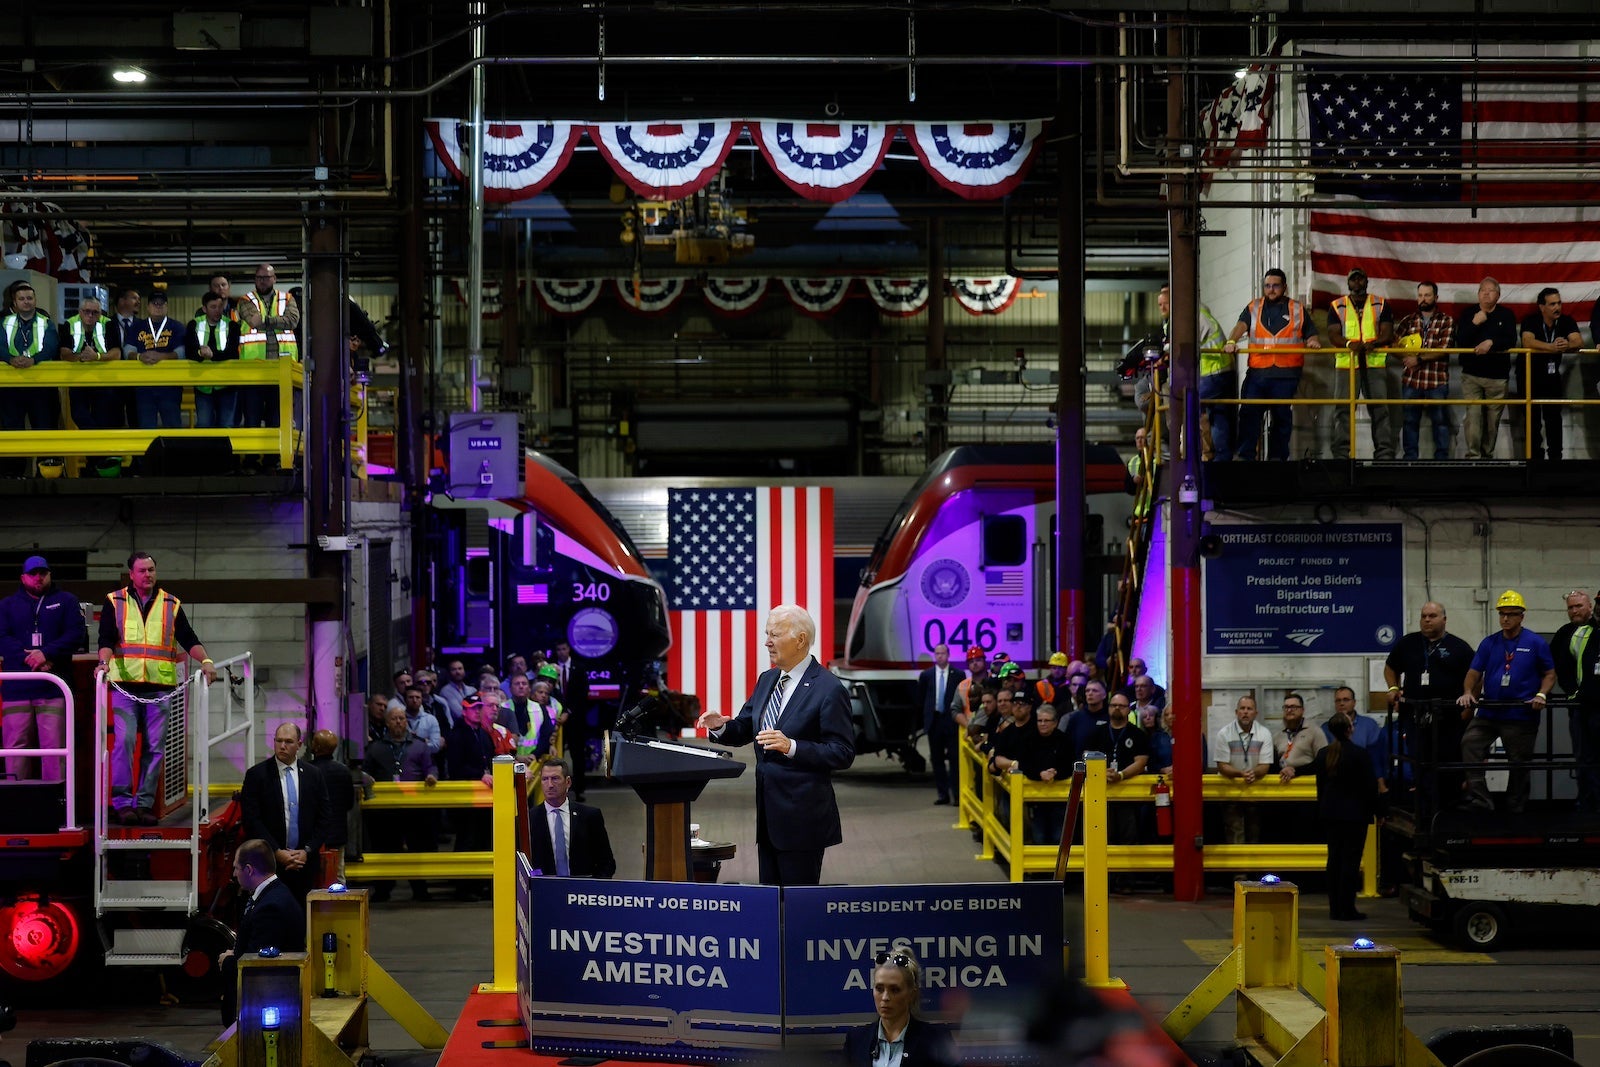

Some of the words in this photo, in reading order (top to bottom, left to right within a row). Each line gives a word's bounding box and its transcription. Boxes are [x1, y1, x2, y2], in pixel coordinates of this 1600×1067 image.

[1220, 533, 1272, 544] ORTHEAST
[1275, 533, 1323, 543] CORRIDOR
[1326, 532, 1392, 543] INVESTMENTS
[1258, 558, 1294, 566] PROJECT
[1301, 558, 1332, 566] FUNDED
[1339, 558, 1349, 566] BY
[1247, 575, 1298, 586] President
[1301, 575, 1321, 586] Joe
[1324, 575, 1362, 585] Biden's
[572, 583, 610, 601] 340
[1277, 590, 1332, 601] Bipartisan
[1256, 604, 1330, 614] Infrastructure
[1332, 604, 1354, 614] Law
[924, 618, 997, 652] 046
[588, 671, 610, 680] C-42
[568, 893, 654, 908] PRESIDENT
[658, 897, 688, 909] JOE
[693, 900, 741, 912] BIDEN
[827, 900, 925, 913] PRESIDENT
[930, 899, 963, 911] JOE
[969, 898, 1021, 910] BIDEN
[550, 929, 719, 958] INVESTING
[729, 937, 760, 960] IN
[1008, 934, 1041, 956] IN
[582, 960, 728, 988] AMERICA
[843, 965, 1007, 990] ARICA
